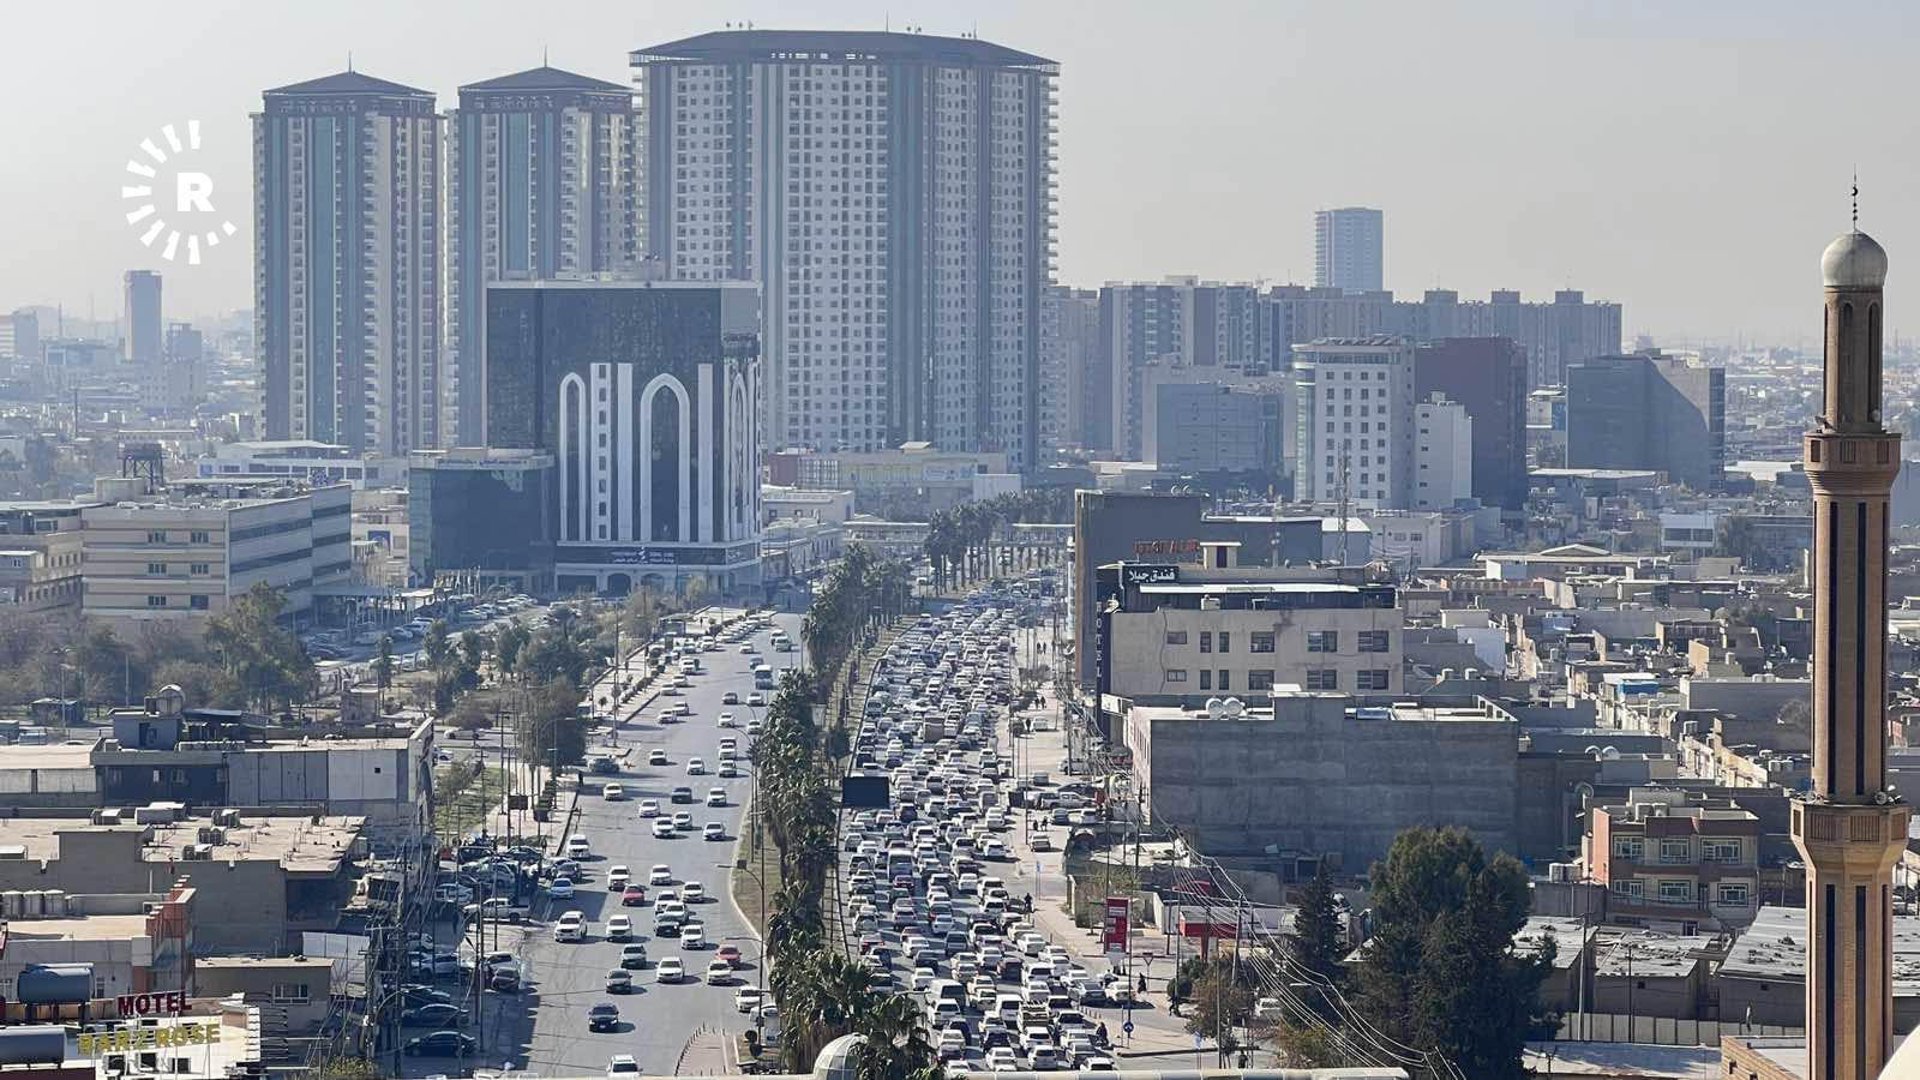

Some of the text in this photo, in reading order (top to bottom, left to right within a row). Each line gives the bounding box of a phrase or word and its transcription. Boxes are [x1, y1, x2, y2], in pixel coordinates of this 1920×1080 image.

[1149, 568, 1175, 583] فندق
[1095, 601, 1103, 678] HOTEL
[117, 991, 193, 1016] MOTEL
[155, 1023, 221, 1048] ROSE
